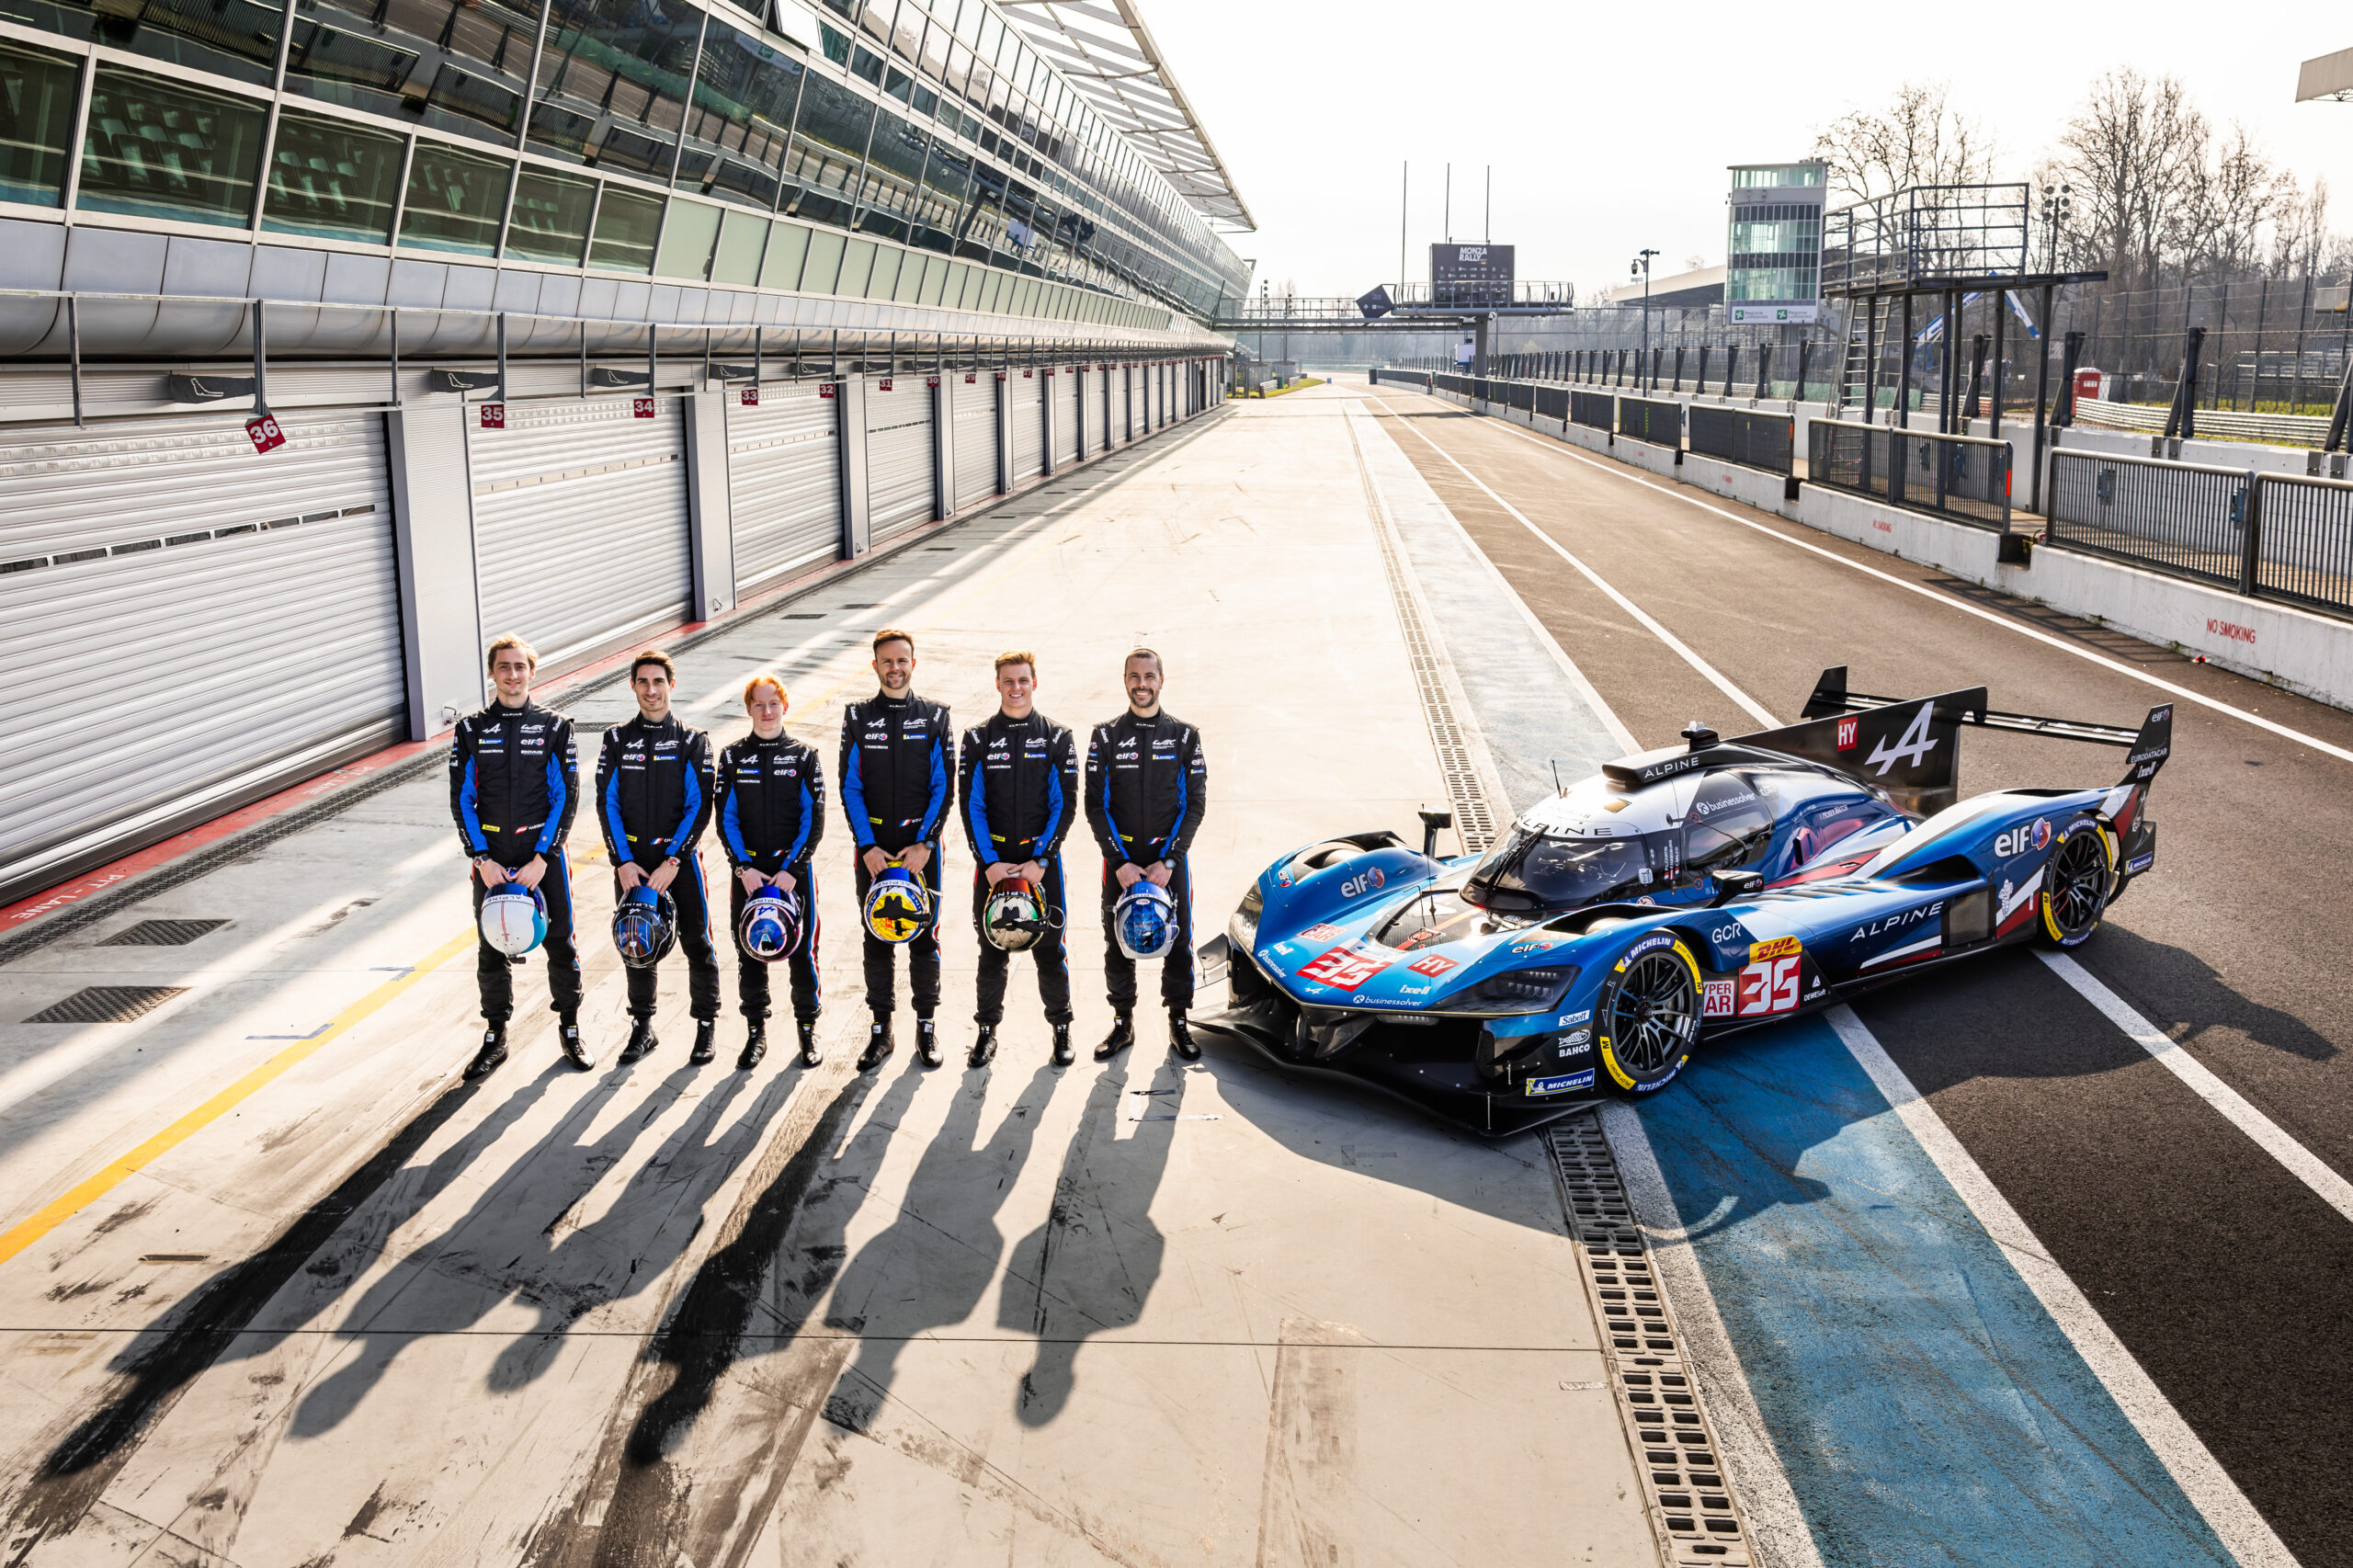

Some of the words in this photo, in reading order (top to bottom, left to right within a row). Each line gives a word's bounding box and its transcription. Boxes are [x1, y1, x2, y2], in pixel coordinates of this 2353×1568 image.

[1460, 246, 1487, 255] MONZA
[820, 385, 834, 394] 32
[881, 380, 892, 388] 31
[743, 391, 757, 401] 33
[482, 406, 503, 421] 35
[634, 401, 654, 413] 34
[250, 419, 278, 443] 36
[2207, 618, 2219, 633] NO
[2219, 621, 2256, 643] SMOKING
[1838, 722, 1857, 746] HY
[2131, 748, 2167, 764] EURODATACAR
[1644, 757, 1699, 778] ALPINE
[2138, 761, 2156, 779] ixell
[1708, 792, 1756, 812] businessolver
[1995, 825, 2029, 858] elf
[88, 874, 126, 888] PIT
[1340, 873, 1368, 898] elf
[1744, 881, 1755, 890] elf
[991, 892, 1034, 901] ALPINE
[11, 895, 77, 919] LANE
[1849, 901, 1944, 943] ALPINE
[1711, 923, 1741, 943] GCR
[1511, 943, 1539, 954] elf
[1631, 937, 1671, 956] MICHELIN
[1757, 937, 1795, 960] DHL
[1262, 952, 1287, 978] businessolver
[1302, 951, 1383, 986] 35
[1412, 956, 1454, 973] HY
[1399, 984, 1432, 994] ixell
[1697, 982, 1702, 990] M
[1703, 983, 1732, 994] YPER
[1739, 956, 1801, 1015] 35
[1366, 996, 1423, 1006] businessolver
[1803, 989, 1826, 1002] DEWESoft
[1704, 996, 1732, 1013] AR
[1563, 1011, 1586, 1025] Sabelt
[1559, 1044, 1590, 1057] BAHCO
[1602, 1040, 1610, 1050] M
[1547, 1074, 1593, 1090] MICHELIN
[1634, 1070, 1677, 1092] MICHELIN
